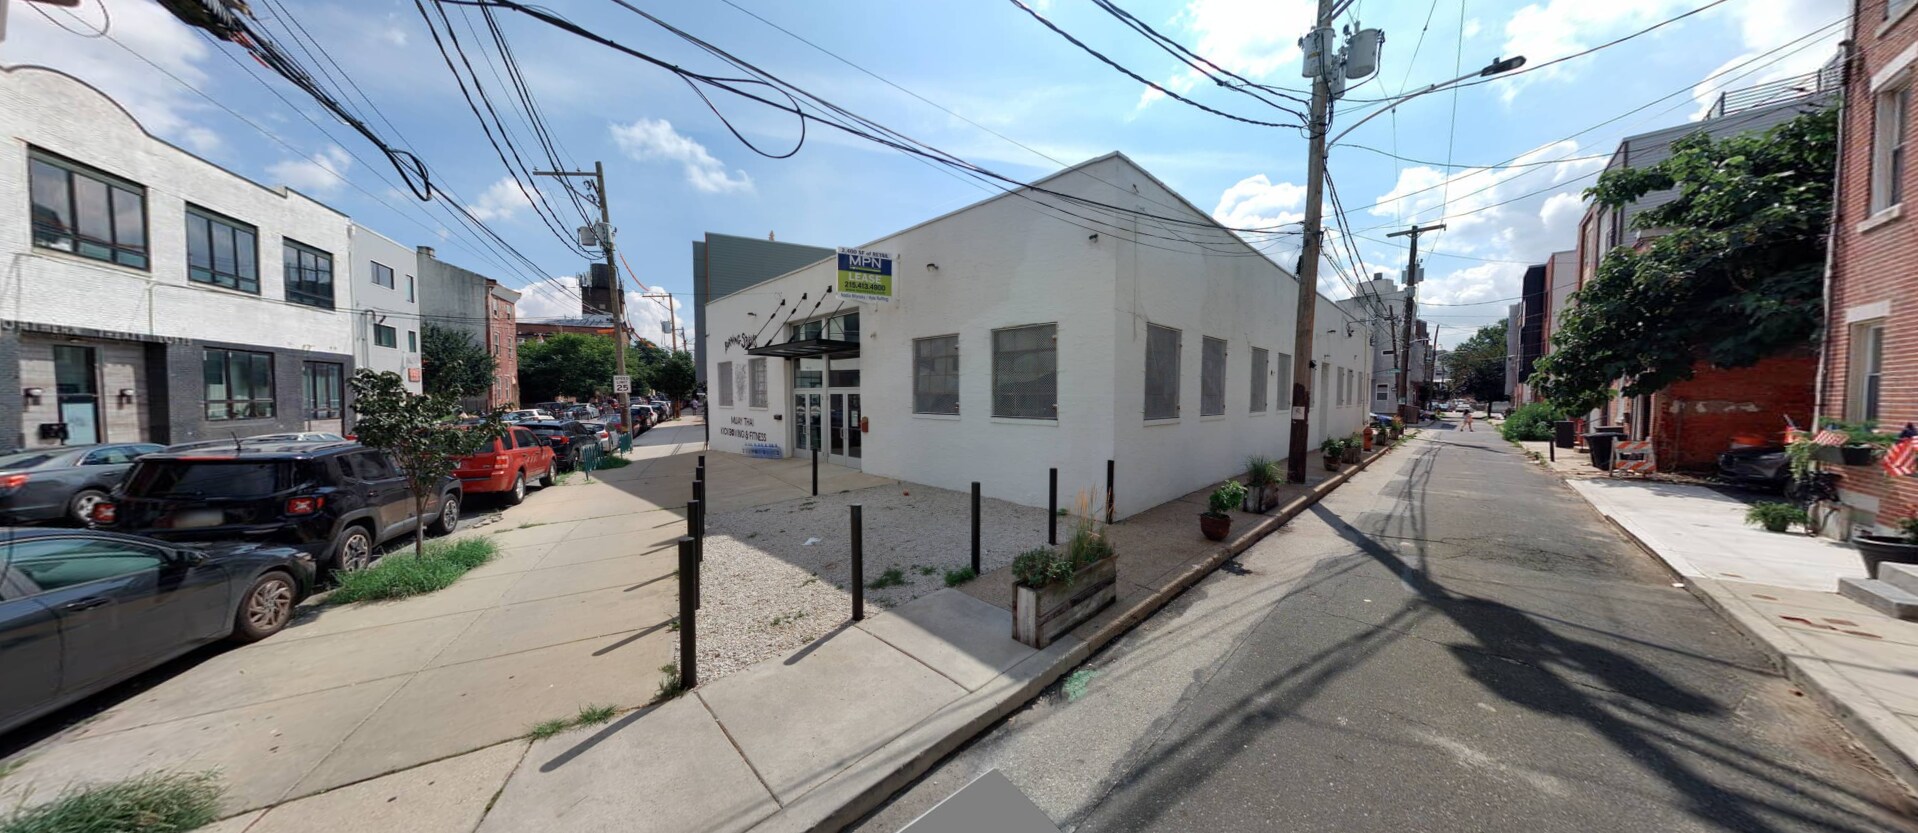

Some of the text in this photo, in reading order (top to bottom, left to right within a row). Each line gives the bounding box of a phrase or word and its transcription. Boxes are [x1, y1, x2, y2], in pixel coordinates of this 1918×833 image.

[849, 255, 881, 269] MPN
[848, 272, 882, 284] LEASE
[731, 416, 754, 427] MUAY THAI
[749, 431, 767, 442] FITNESS
